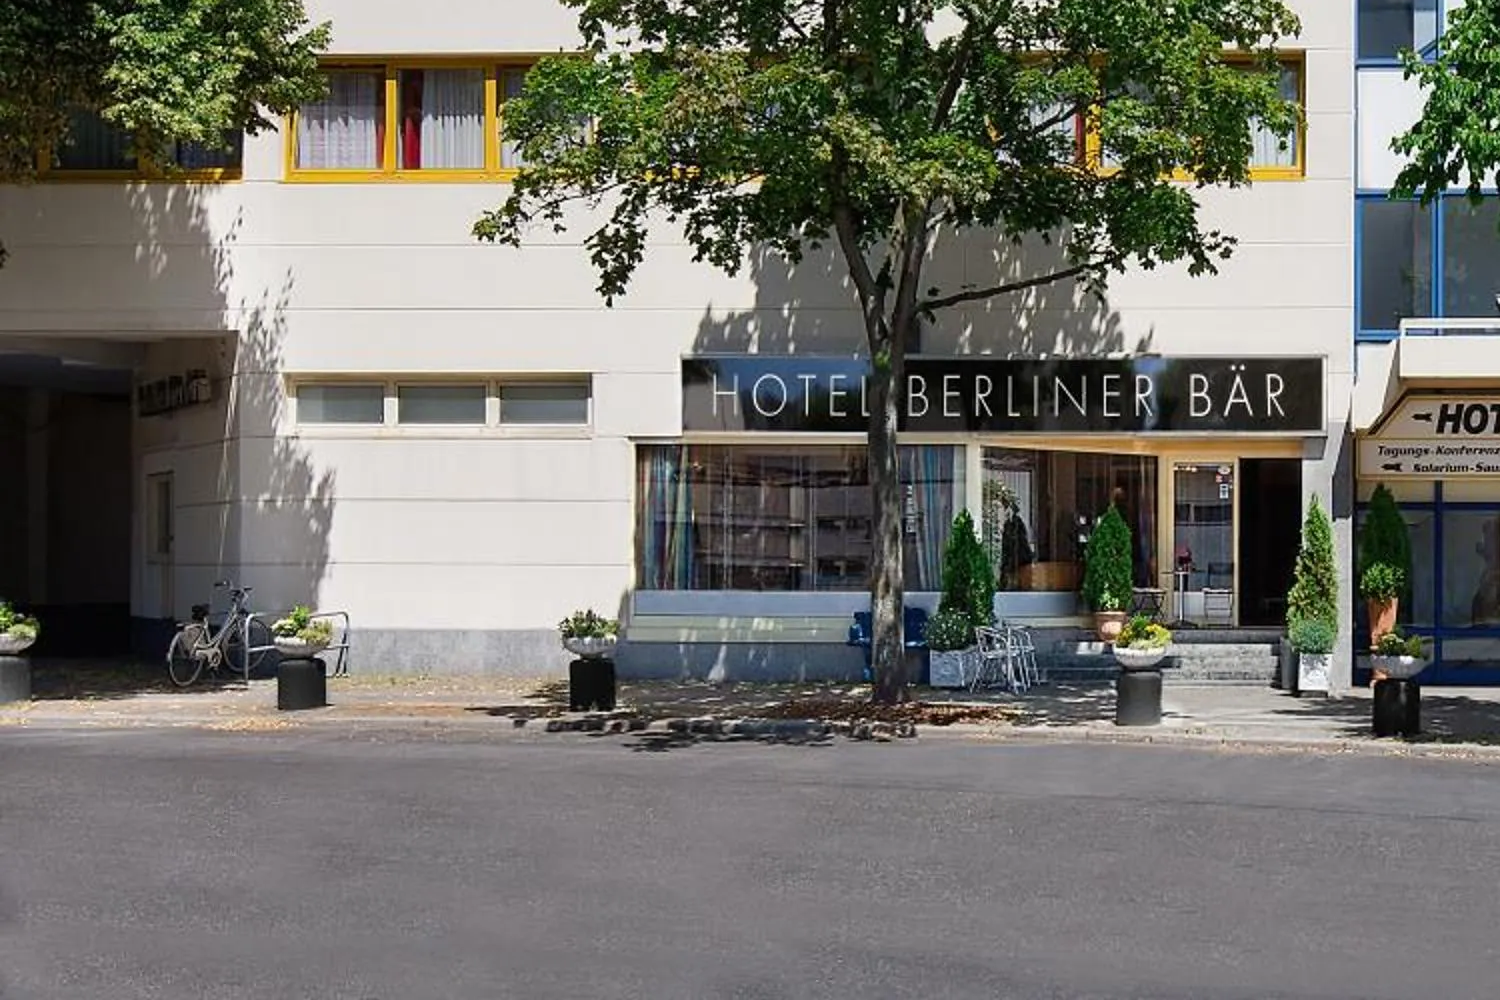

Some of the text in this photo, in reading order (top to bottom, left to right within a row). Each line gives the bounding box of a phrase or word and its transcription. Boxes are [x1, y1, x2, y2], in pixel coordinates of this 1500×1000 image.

[711, 364, 1285, 418] HOTEL BERLINER BÄR
